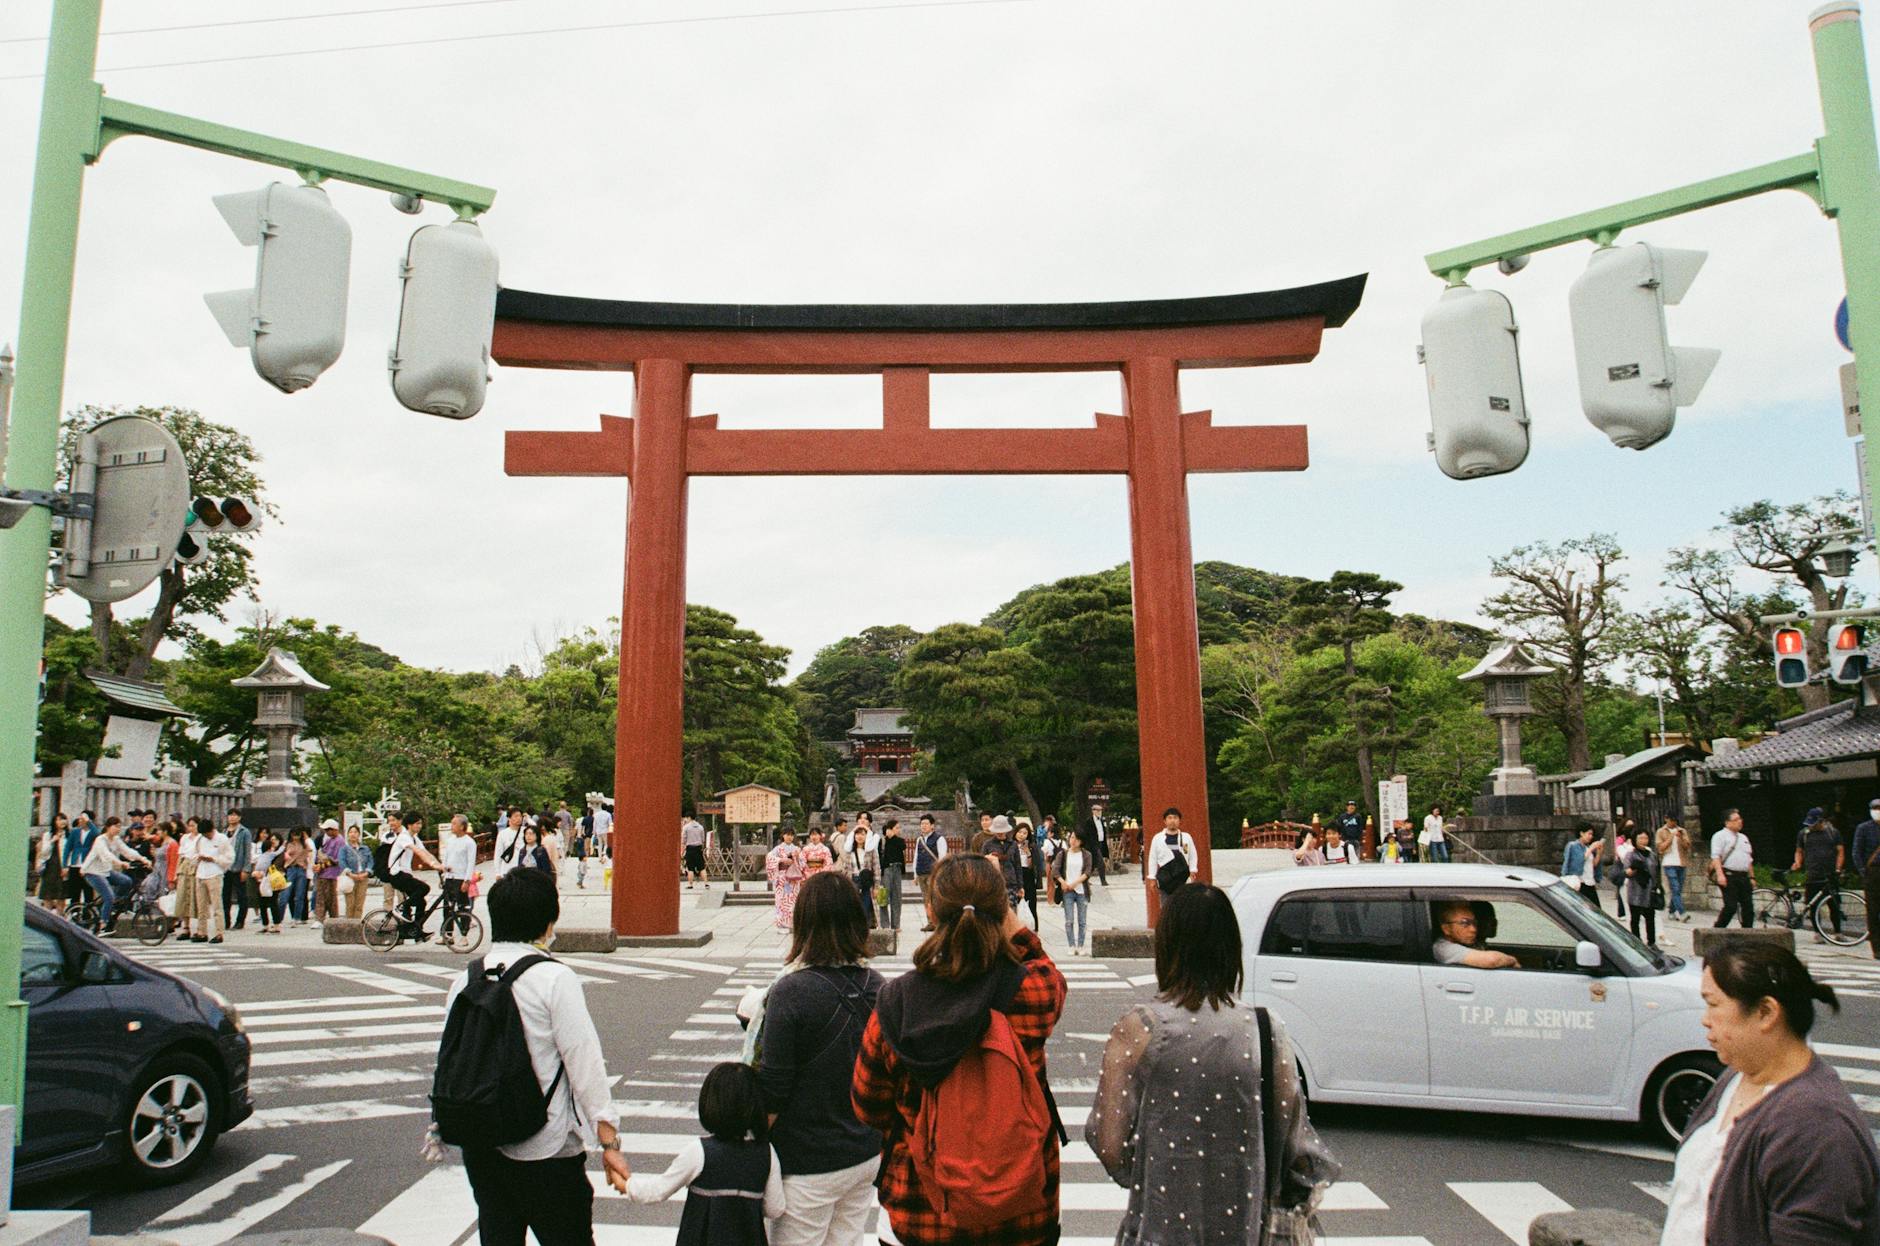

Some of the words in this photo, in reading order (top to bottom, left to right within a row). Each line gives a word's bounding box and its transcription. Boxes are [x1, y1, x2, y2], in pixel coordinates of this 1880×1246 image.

[1459, 1006, 1498, 1025] T.F.P.
[1504, 1007, 1529, 1027] AIR
[1534, 1008, 1595, 1029] SERVICE
